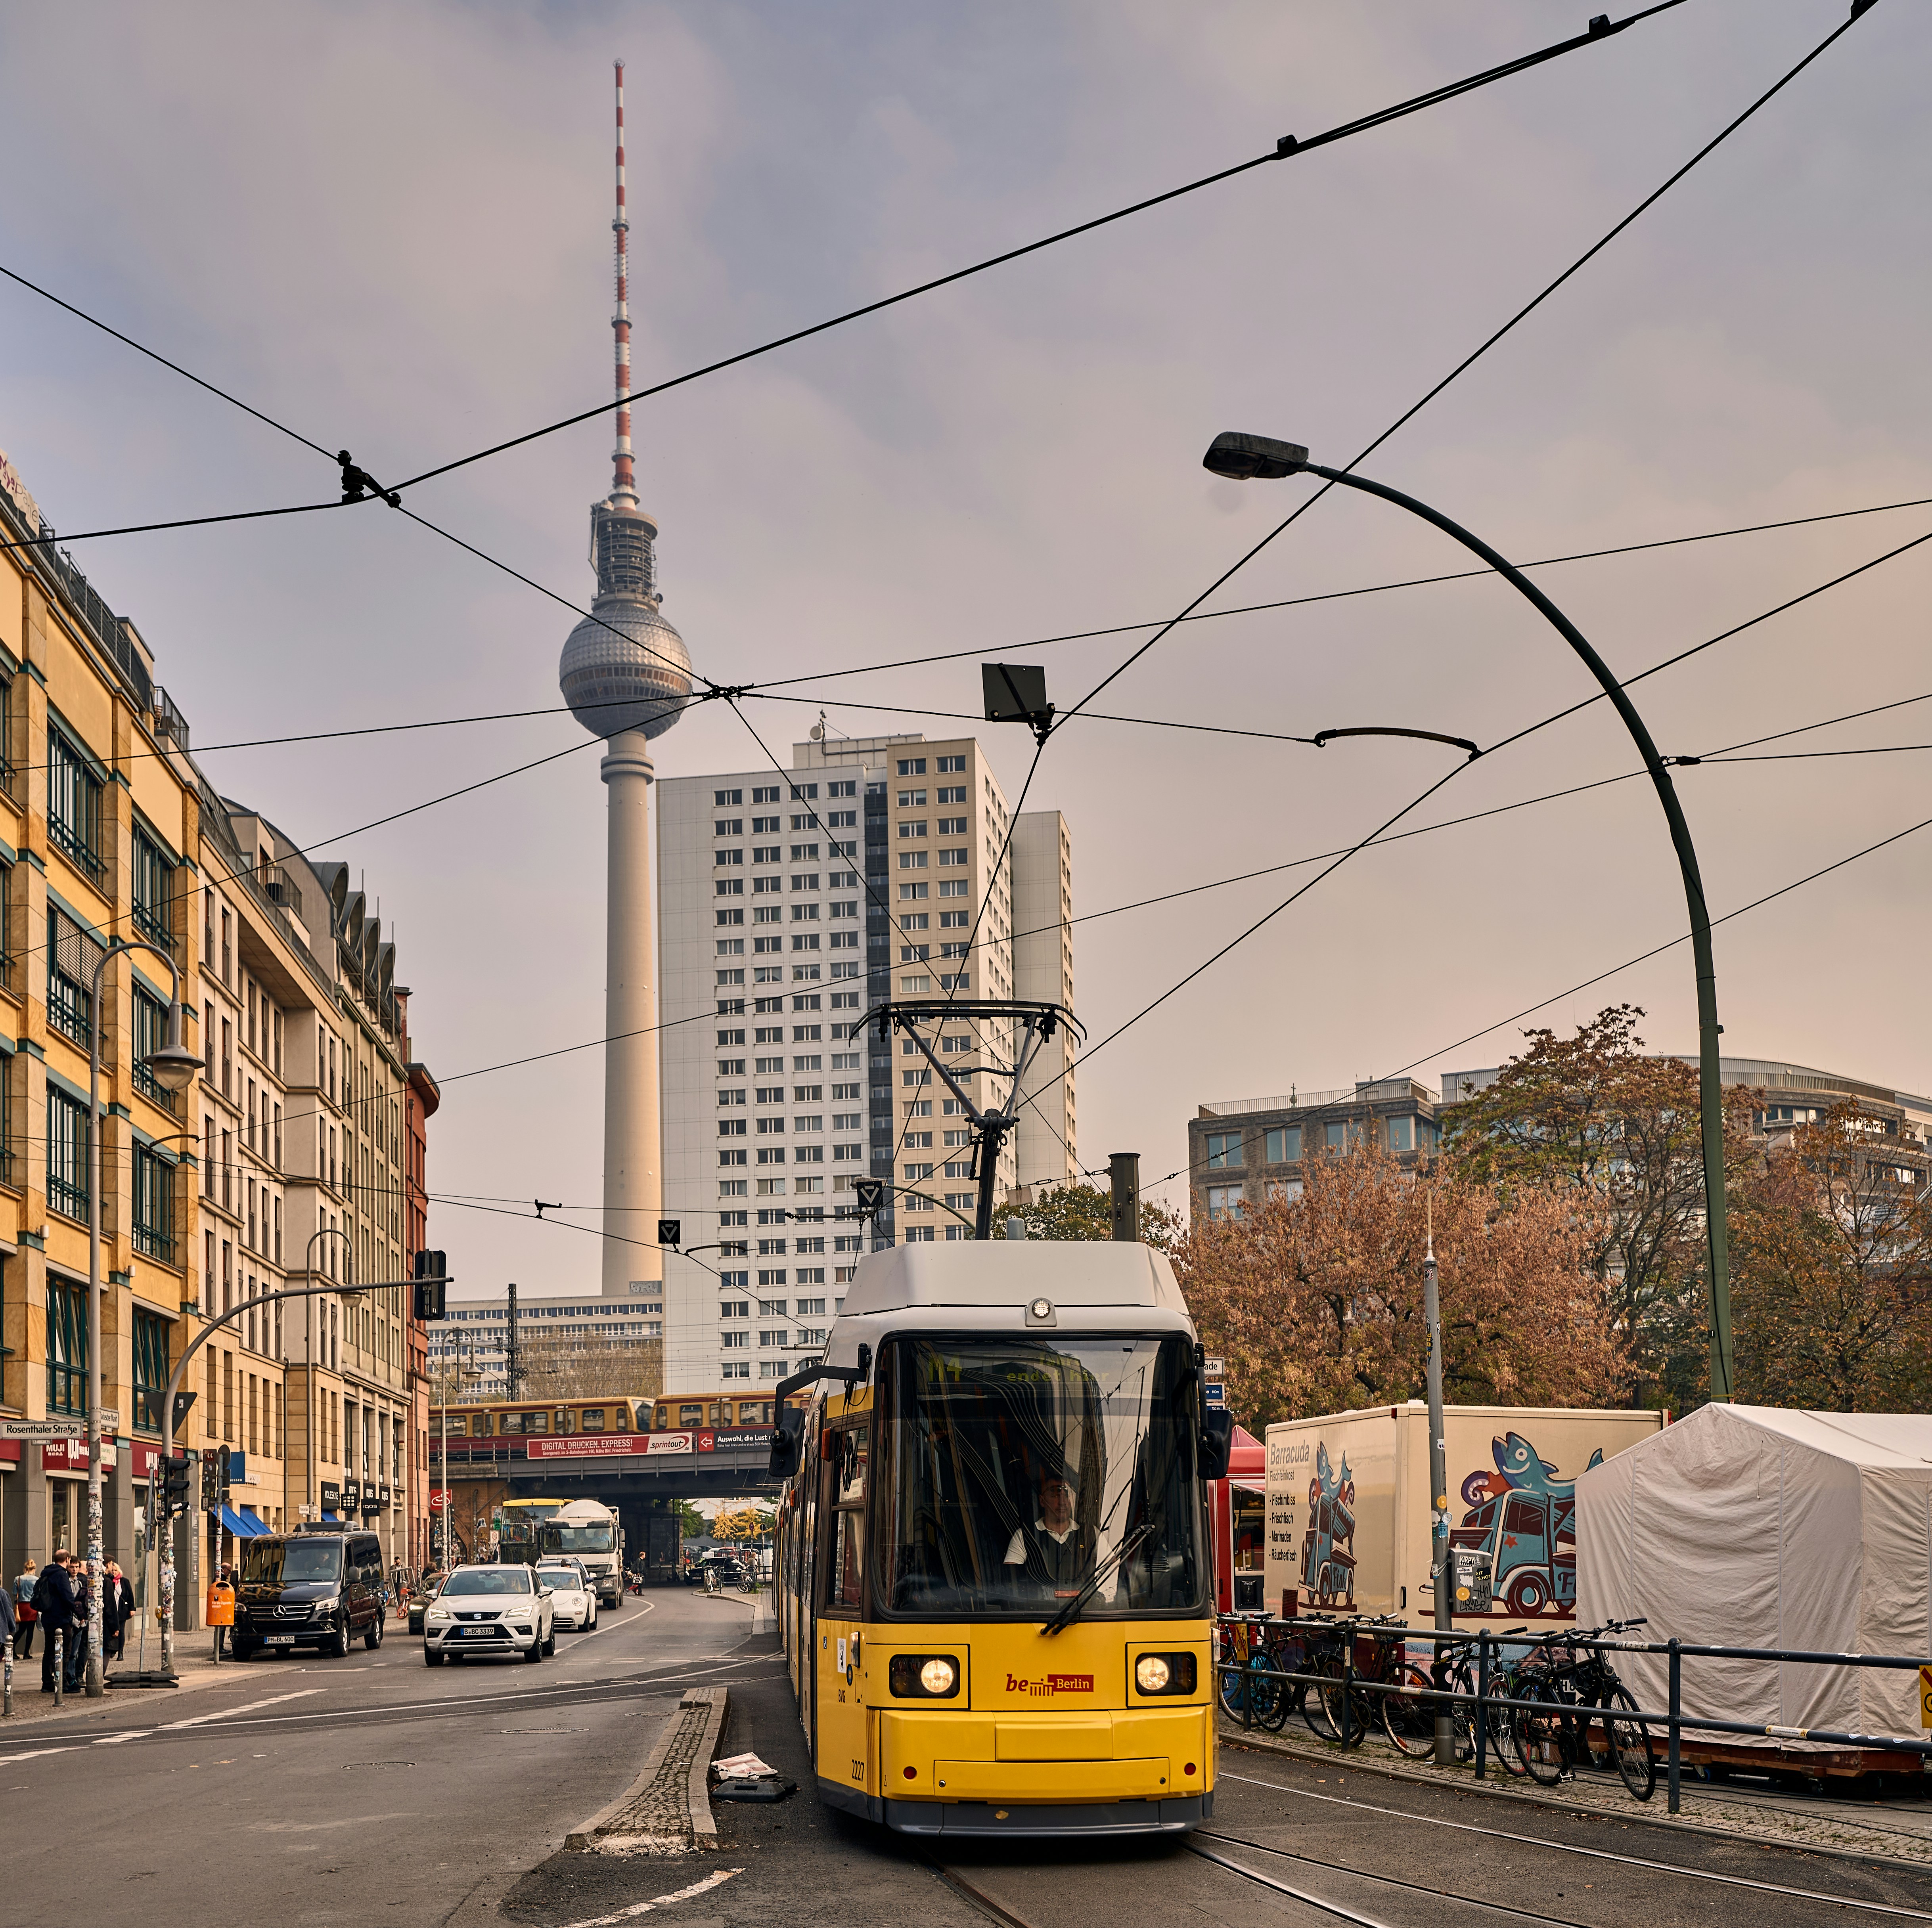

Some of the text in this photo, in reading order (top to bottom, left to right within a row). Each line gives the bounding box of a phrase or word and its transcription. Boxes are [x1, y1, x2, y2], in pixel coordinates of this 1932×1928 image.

[1204, 1361, 1218, 1370] ade
[7, 1424, 77, 1435] Rosenthaler Straße
[542, 1439, 633, 1450] DIGITAL DRUCKEN. EXPRESS!
[650, 1440, 684, 1450] sprintout
[1270, 1440, 1309, 1465] Barracuda
[1269, 1471, 1294, 1482] Fischfeinkost
[325, 1490, 338, 1500] MOLESKINE
[1272, 1494, 1295, 1506] Fischimbiss
[1271, 1512, 1293, 1524] Frischfisch
[1271, 1530, 1292, 1543] Marinaden
[1271, 1548, 1297, 1562] Räucherfisch
[1460, 1556, 1475, 1564] KIRPY
[1333, 1566, 1346, 1589] Fish
[1005, 1674, 1090, 1692] be Berlin
[852, 1759, 864, 1782] 2227
